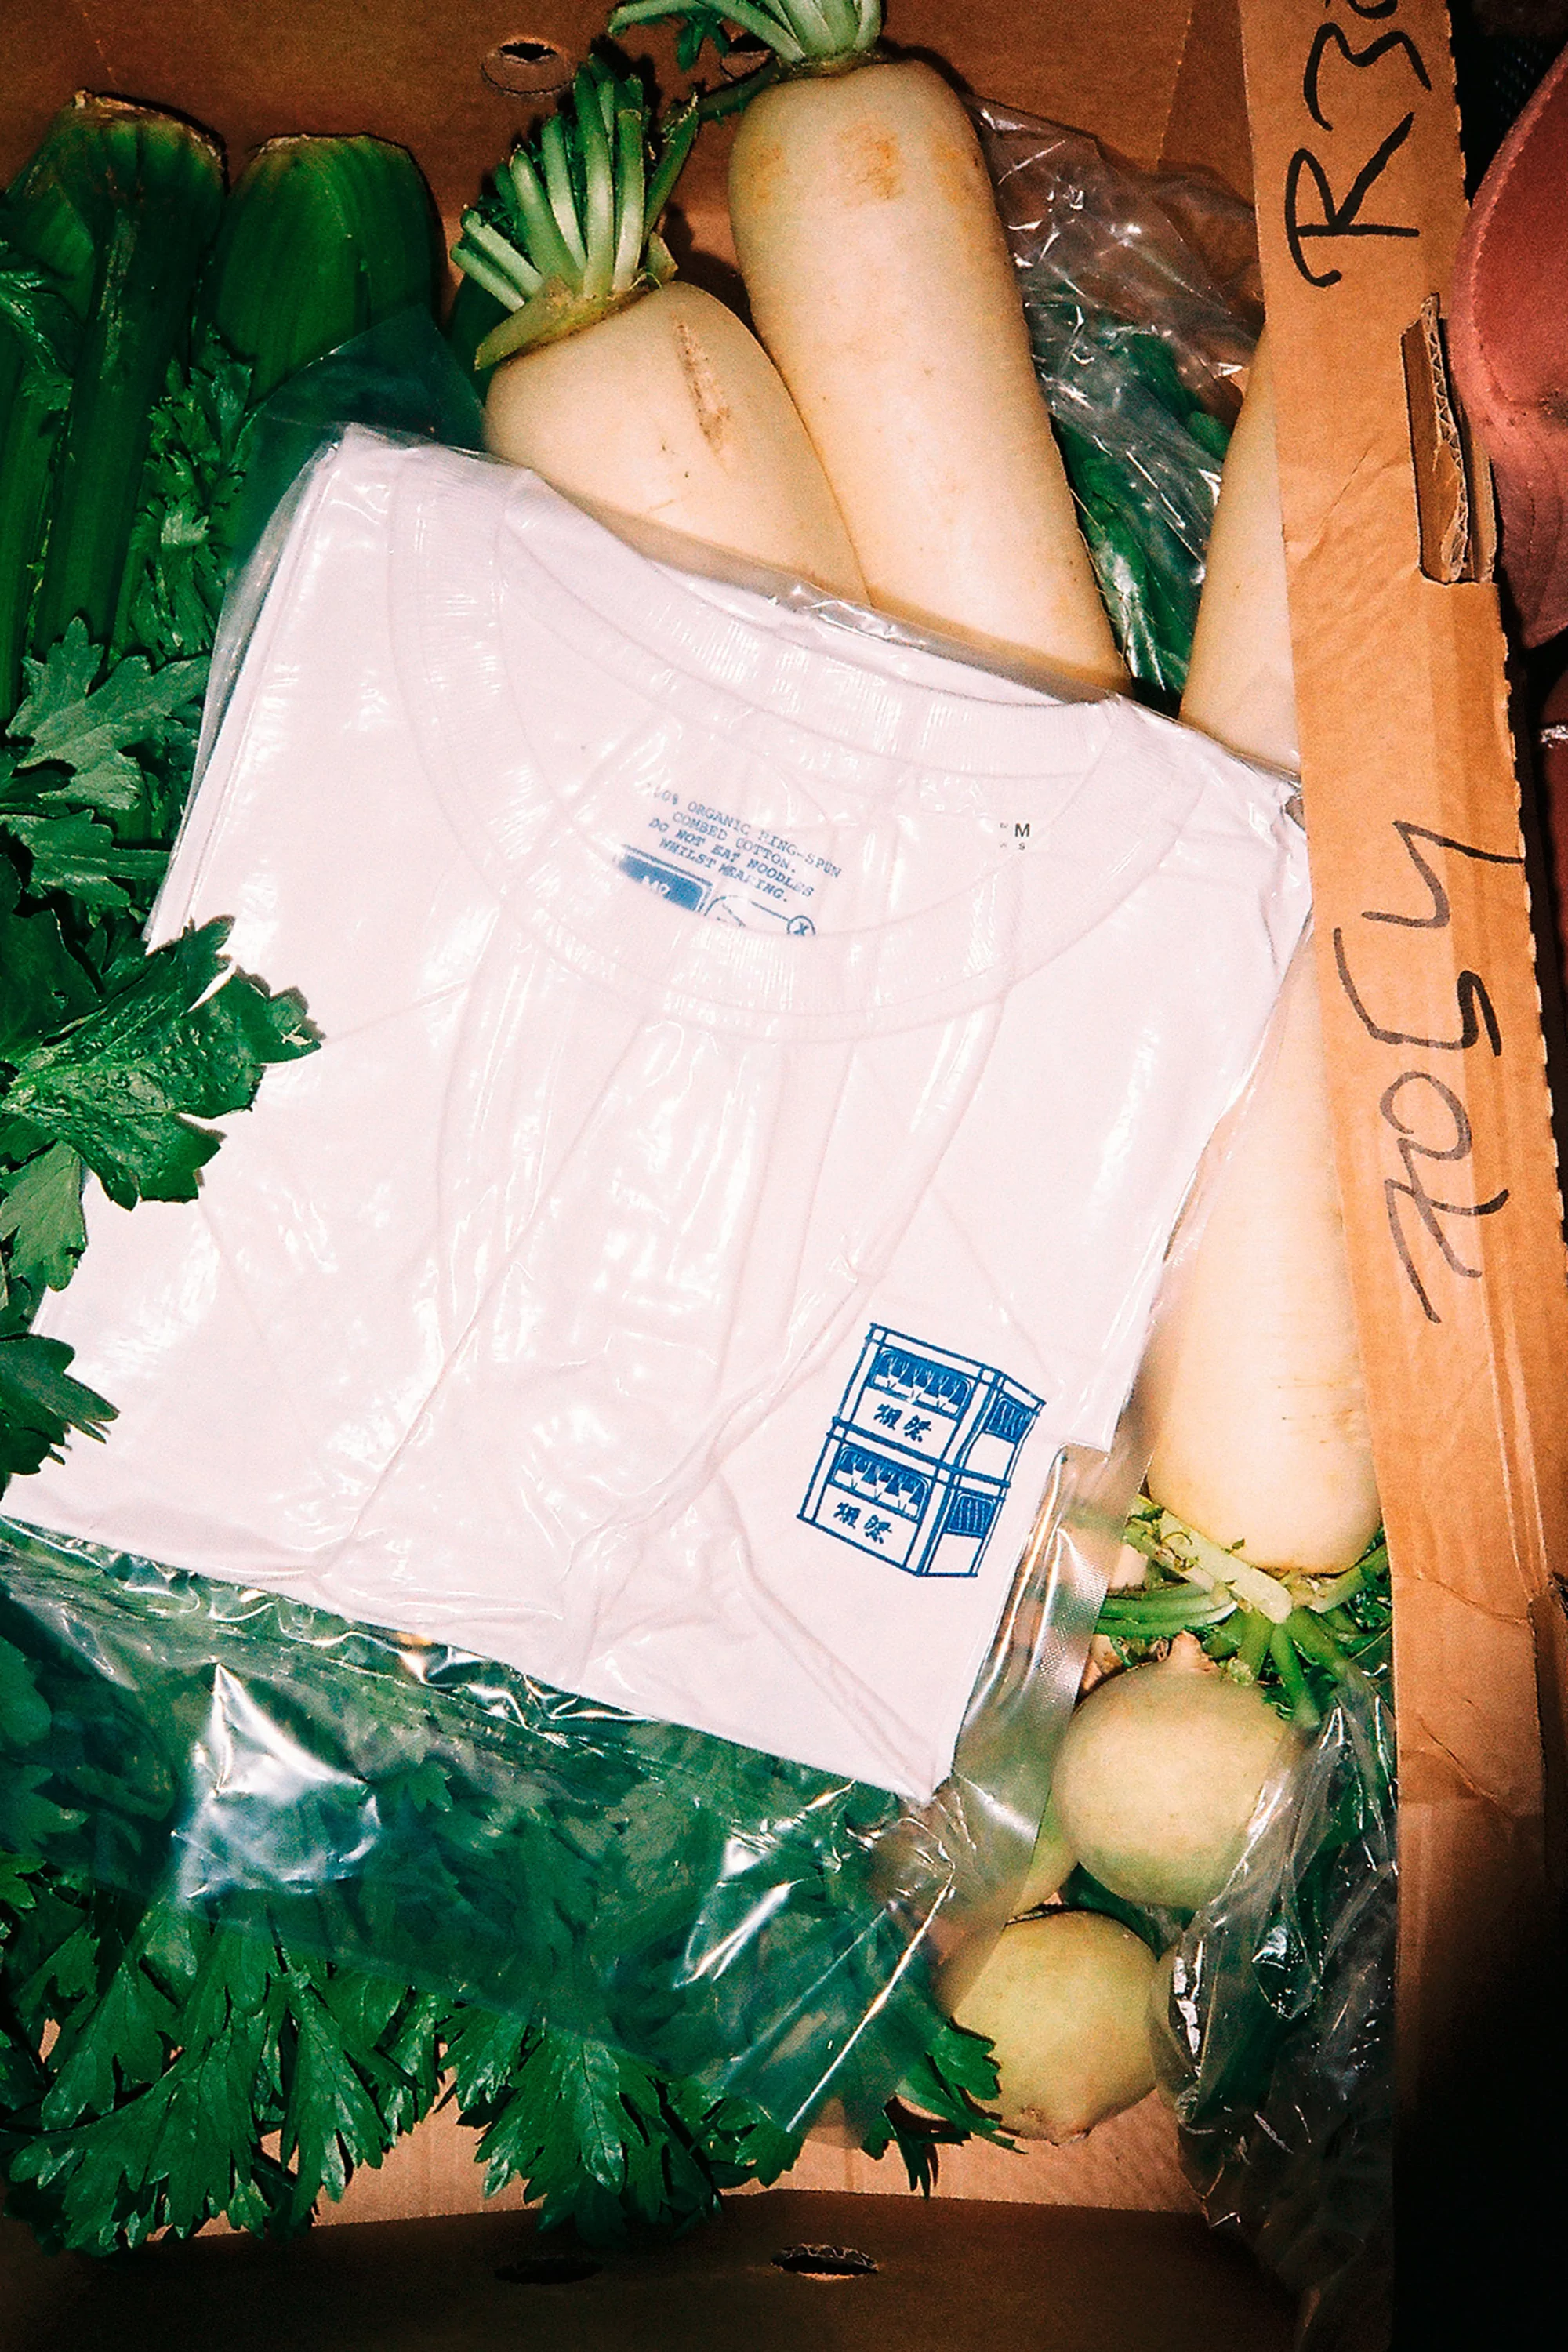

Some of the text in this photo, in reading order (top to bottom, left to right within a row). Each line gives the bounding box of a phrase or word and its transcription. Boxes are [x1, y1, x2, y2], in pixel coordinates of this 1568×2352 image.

[645, 782, 679, 805] 00%
[688, 801, 751, 836] ORGANIC
[1014, 822, 1030, 837] M
[648, 818, 815, 897] DO NOT EAT NOODLES
[659, 837, 717, 869] WHILST
[673, 811, 796, 873] COMBED COTTON.
